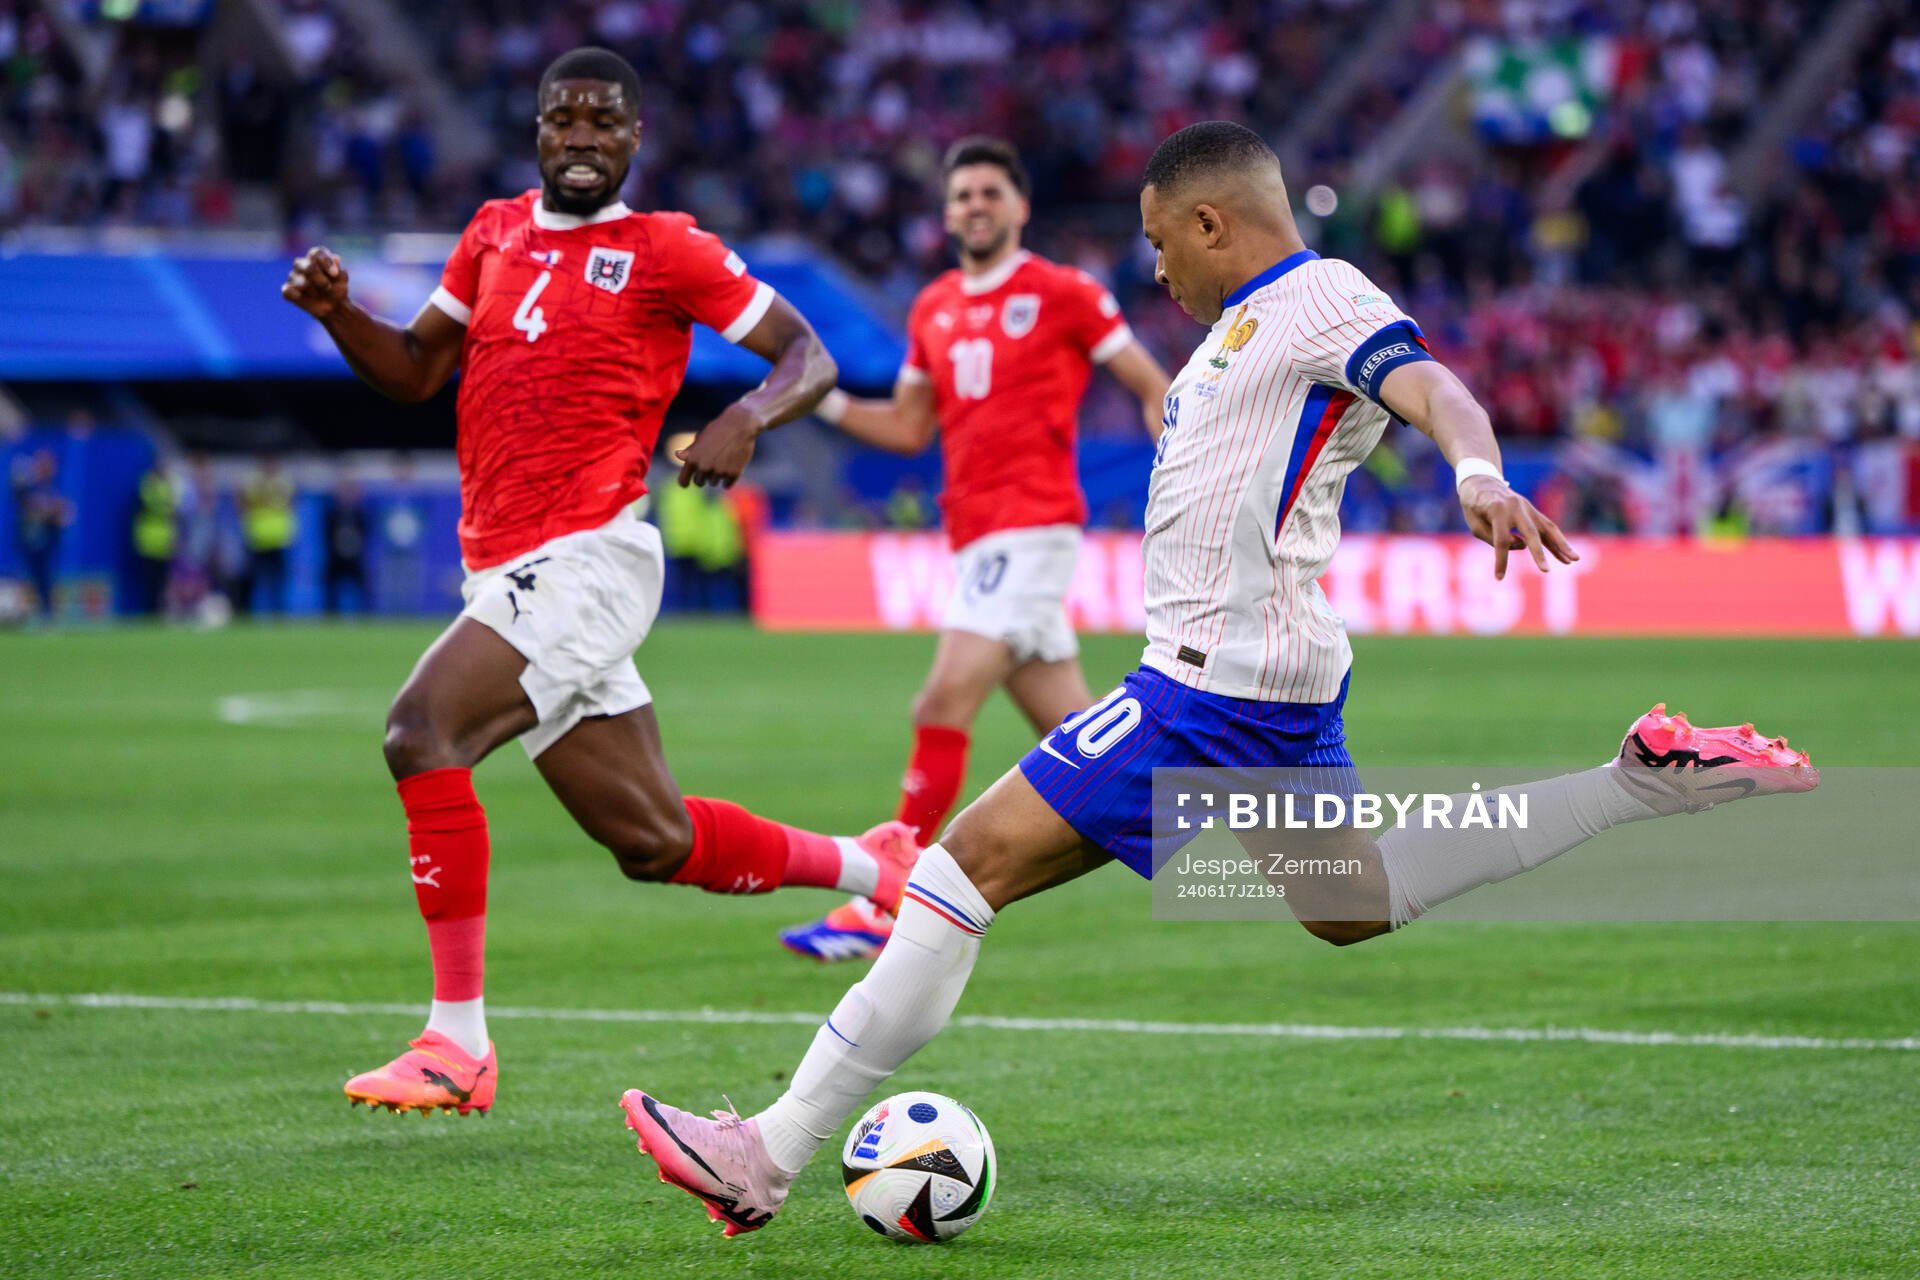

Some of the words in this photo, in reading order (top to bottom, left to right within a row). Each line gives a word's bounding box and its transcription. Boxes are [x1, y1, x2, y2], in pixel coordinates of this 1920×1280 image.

[513, 270, 548, 343] 4
[949, 336, 994, 400] 10
[1362, 344, 1412, 379] RESPECT
[1060, 686, 1142, 759] 10
